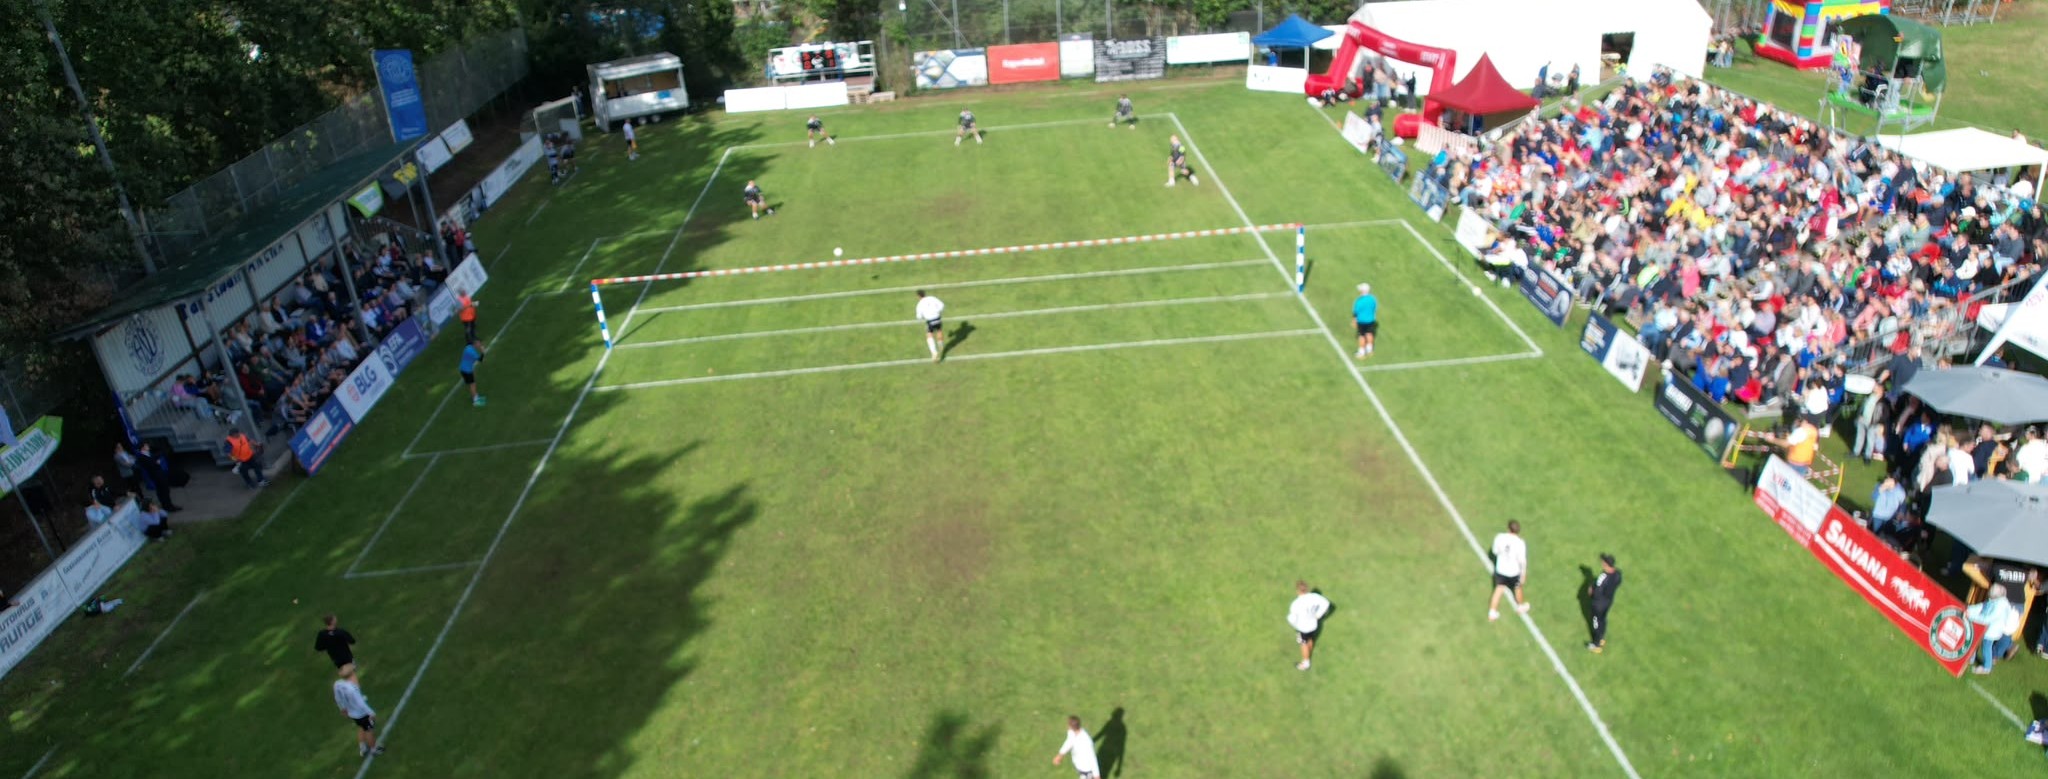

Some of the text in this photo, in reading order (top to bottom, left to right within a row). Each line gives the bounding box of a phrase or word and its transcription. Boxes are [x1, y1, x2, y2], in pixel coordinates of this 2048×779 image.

[353, 365, 377, 396] BLG
[1825, 519, 1888, 587] SALVANA
[0, 597, 35, 632] UTOHAUS
